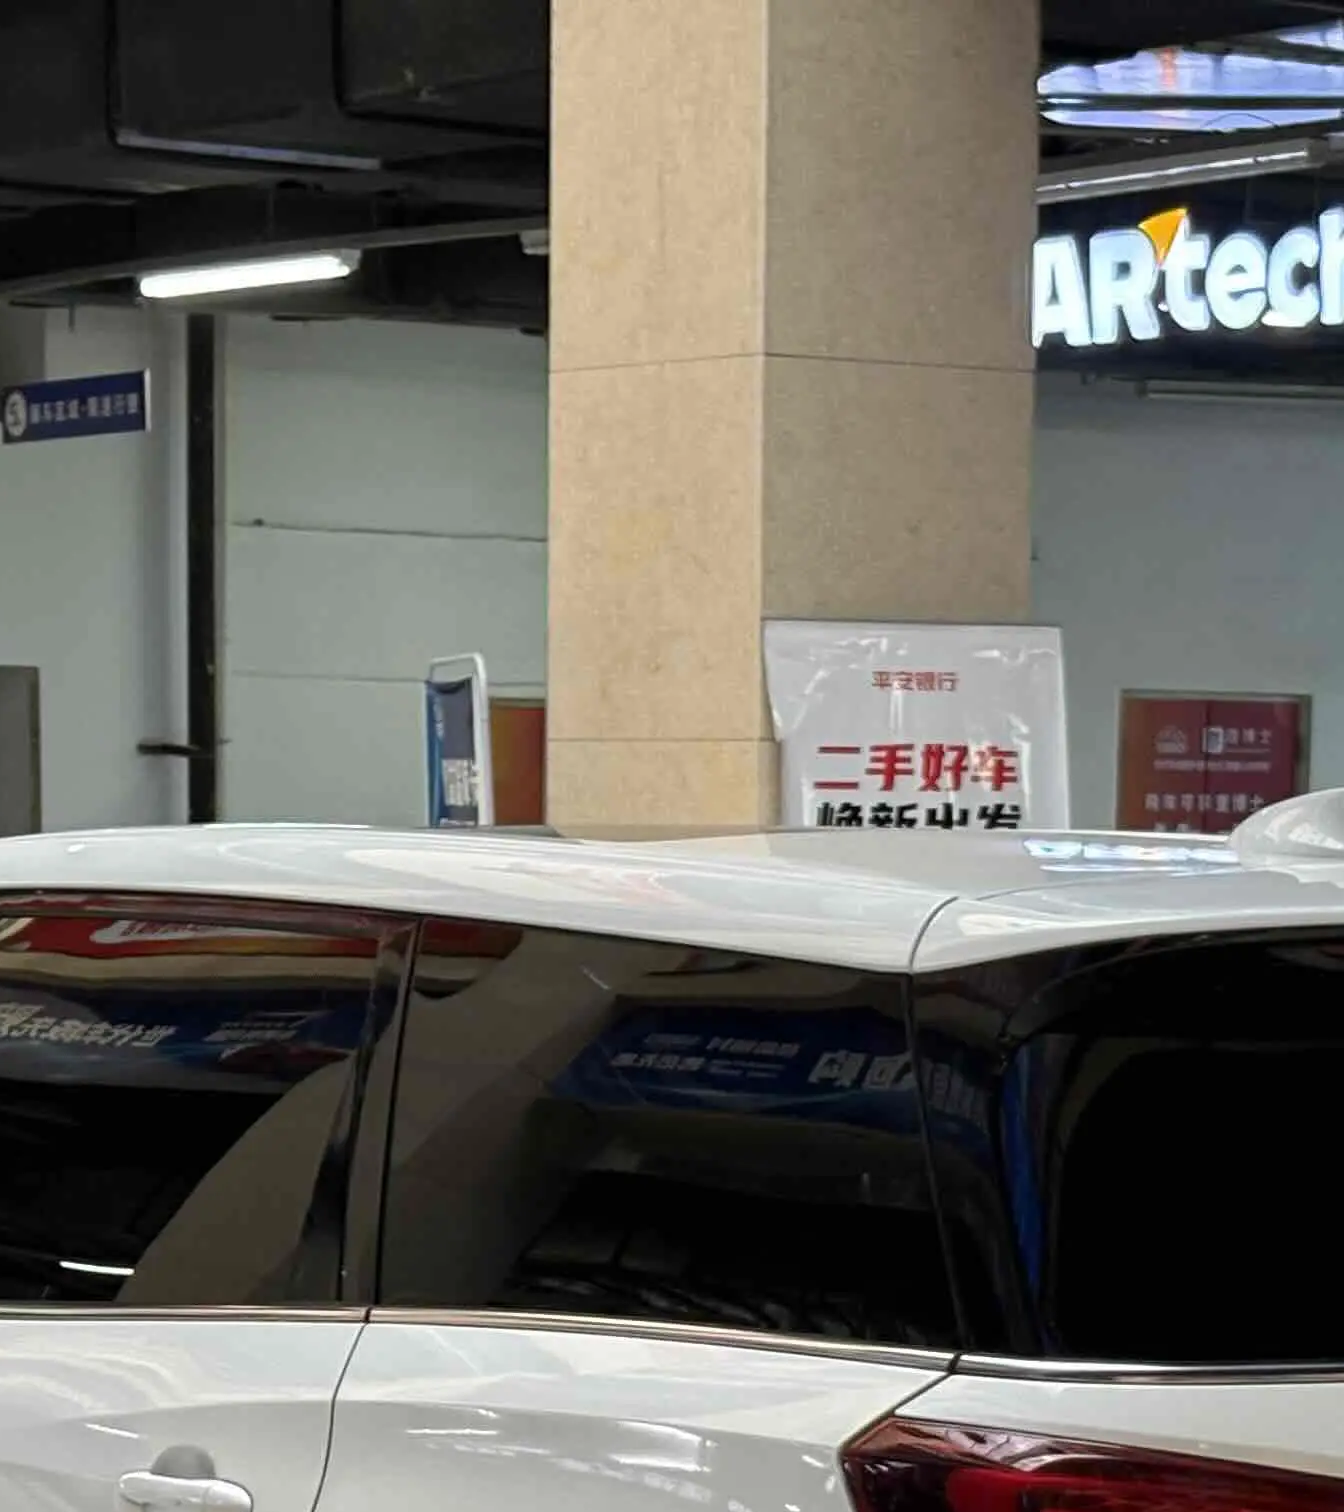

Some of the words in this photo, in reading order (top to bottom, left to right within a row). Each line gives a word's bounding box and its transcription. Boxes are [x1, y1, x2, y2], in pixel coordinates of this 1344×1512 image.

[871, 671, 960, 692] 平安银行
[813, 743, 1019, 792] 二手好车
